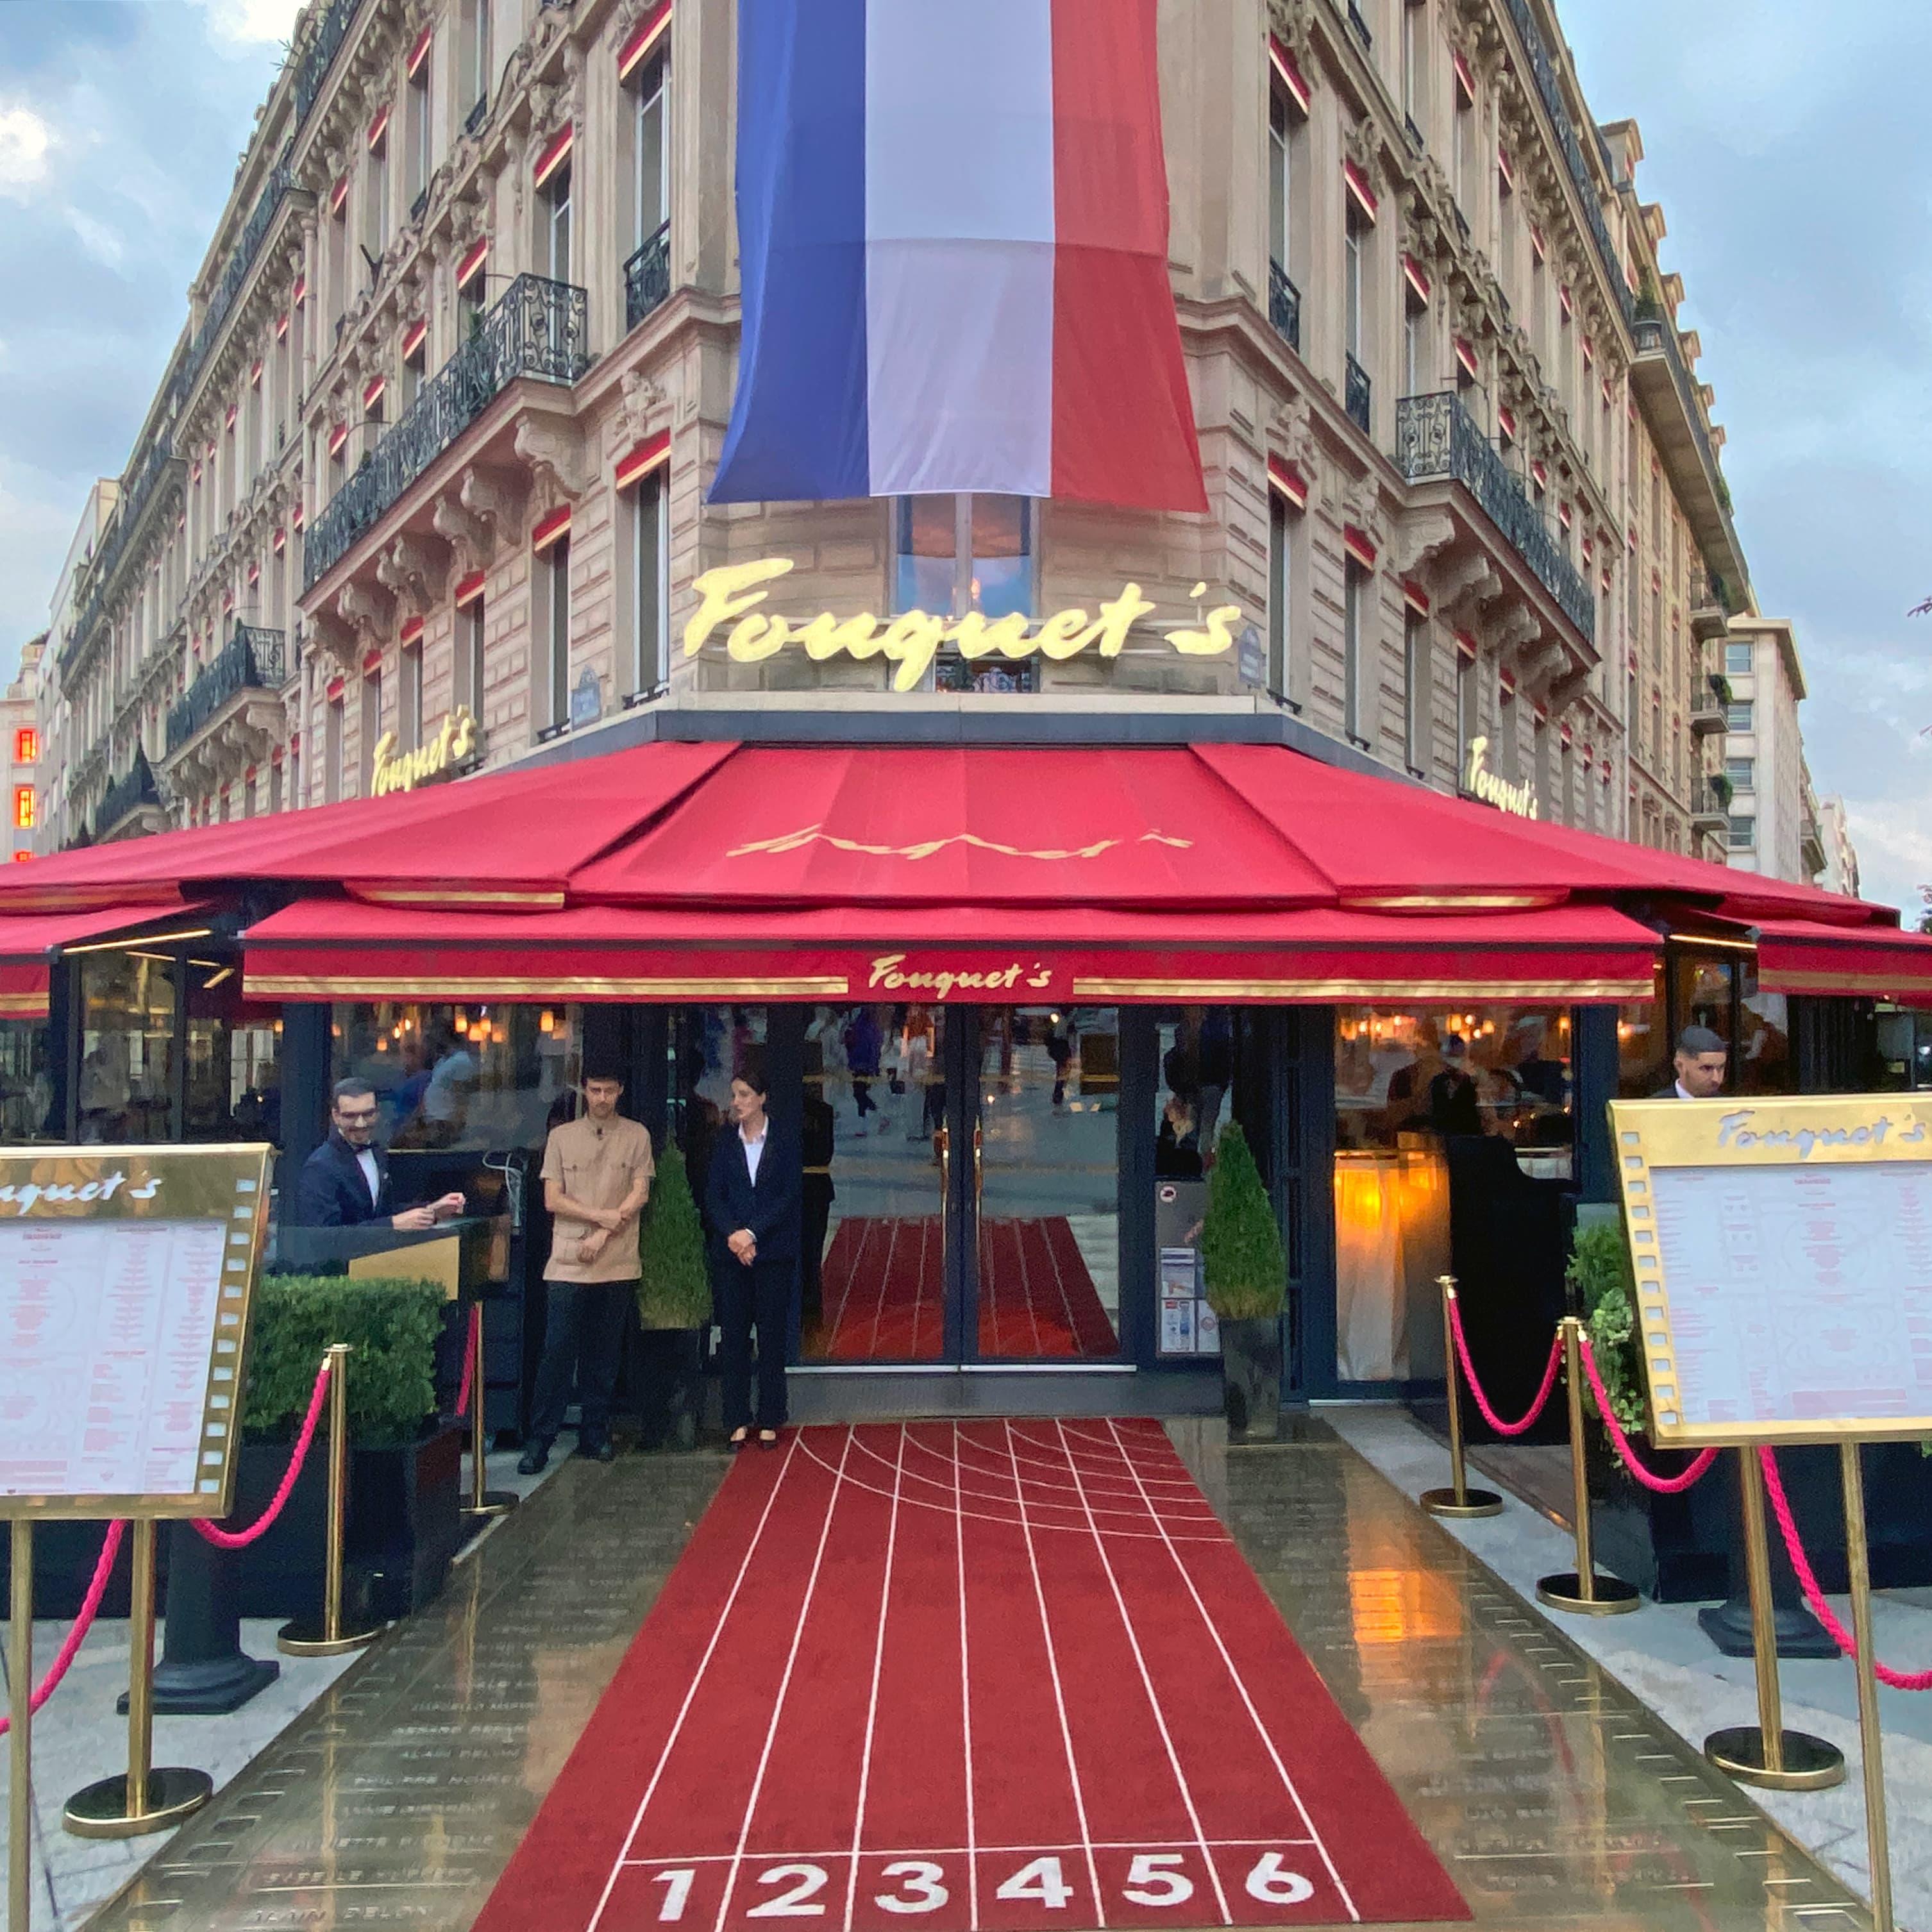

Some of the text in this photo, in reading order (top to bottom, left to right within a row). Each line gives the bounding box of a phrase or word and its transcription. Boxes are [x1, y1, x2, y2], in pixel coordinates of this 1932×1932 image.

[682, 557, 1242, 693] Fouquet's
[371, 704, 476, 798] Fouquet's
[1465, 735, 1538, 821] Fouquet's
[869, 953, 1052, 1000] Fouquet's
[1718, 1110, 1926, 1160] Fouquet's
[650, 1852, 1315, 1921] 1 2 3 4 5 6
